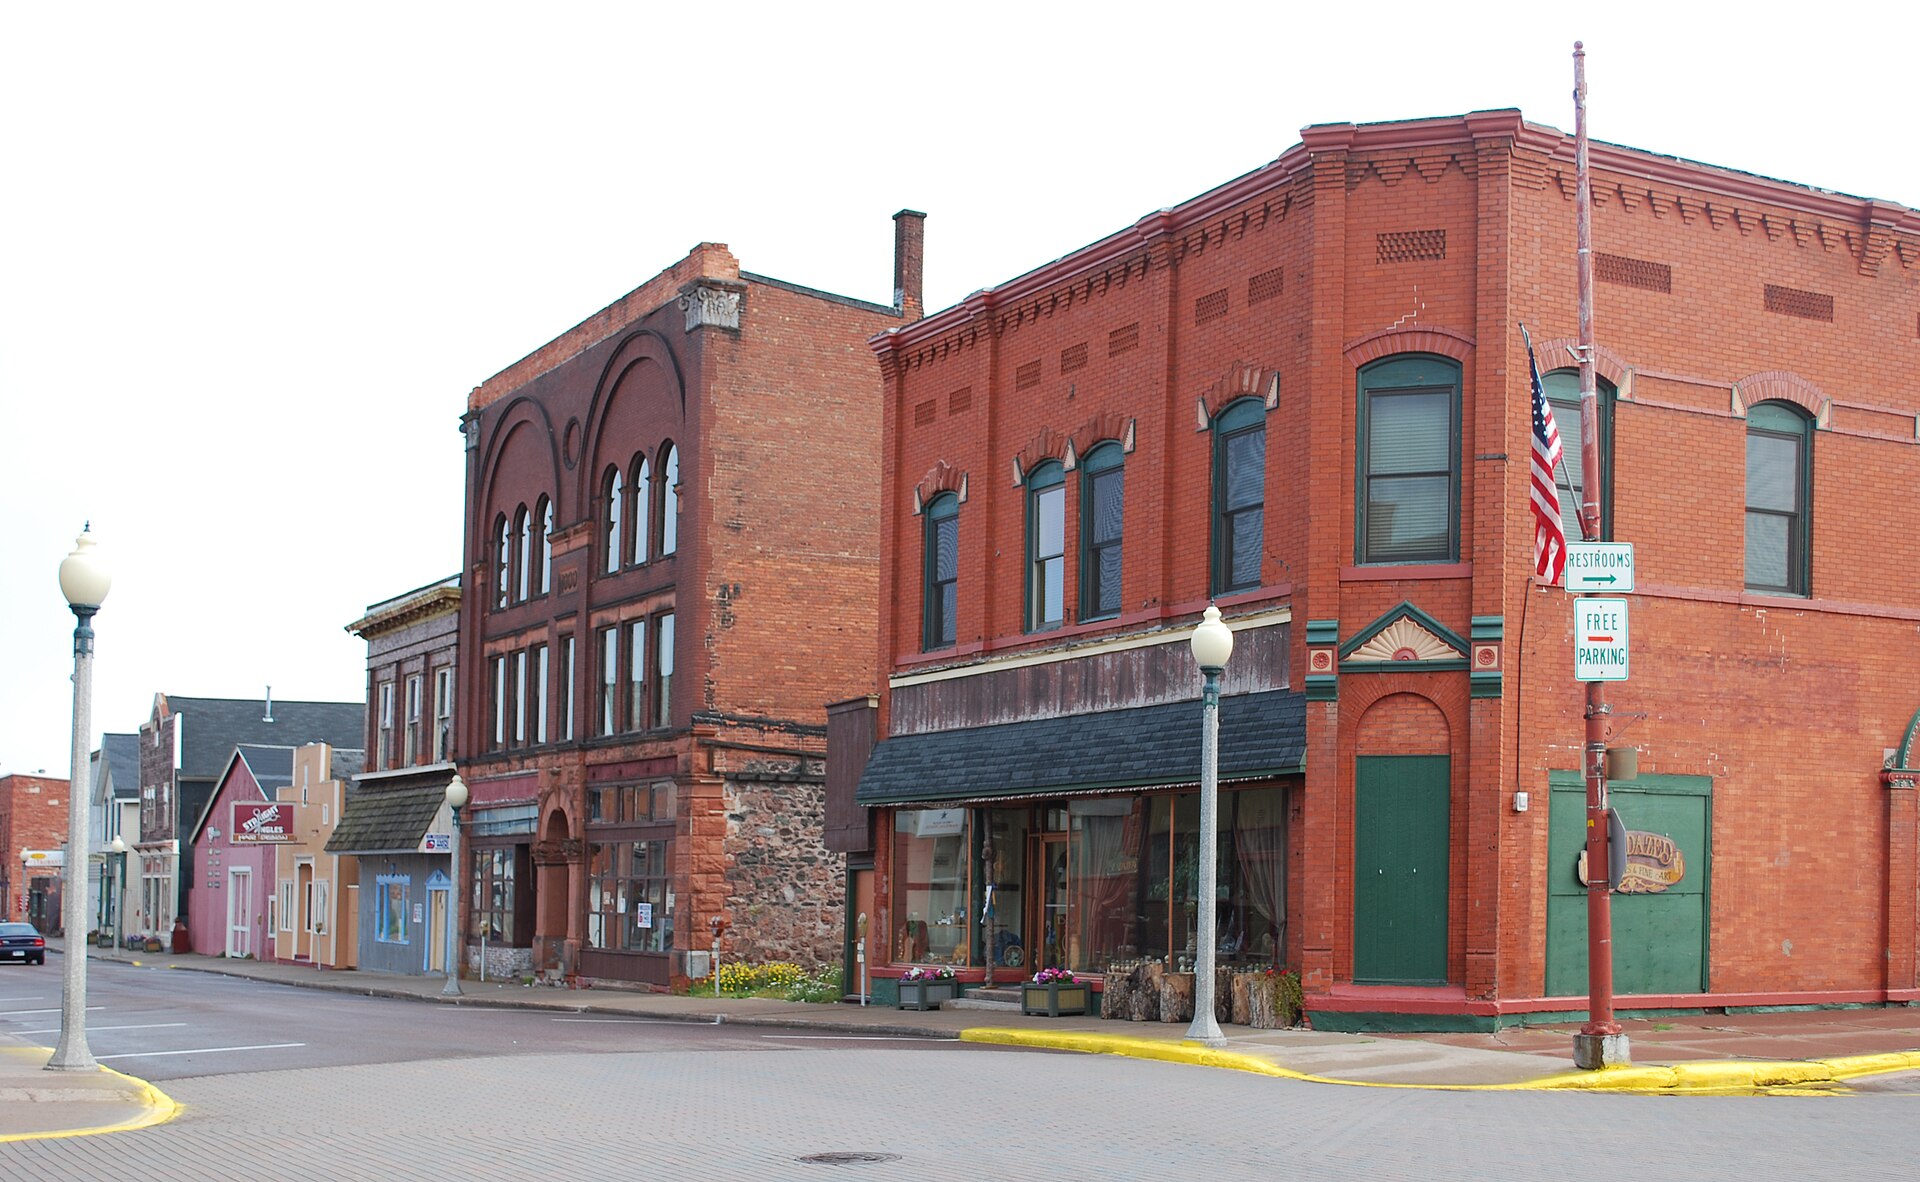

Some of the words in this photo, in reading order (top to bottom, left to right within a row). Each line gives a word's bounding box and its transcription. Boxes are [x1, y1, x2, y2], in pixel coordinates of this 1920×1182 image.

[1568, 552, 1631, 568] RESTROOMS
[1586, 613, 1618, 631] FREE
[1579, 647, 1625, 666] PARKING
[26, 858, 62, 866] STAURANT
[1639, 866, 1653, 879] FINE
[1658, 870, 1672, 881] ART
